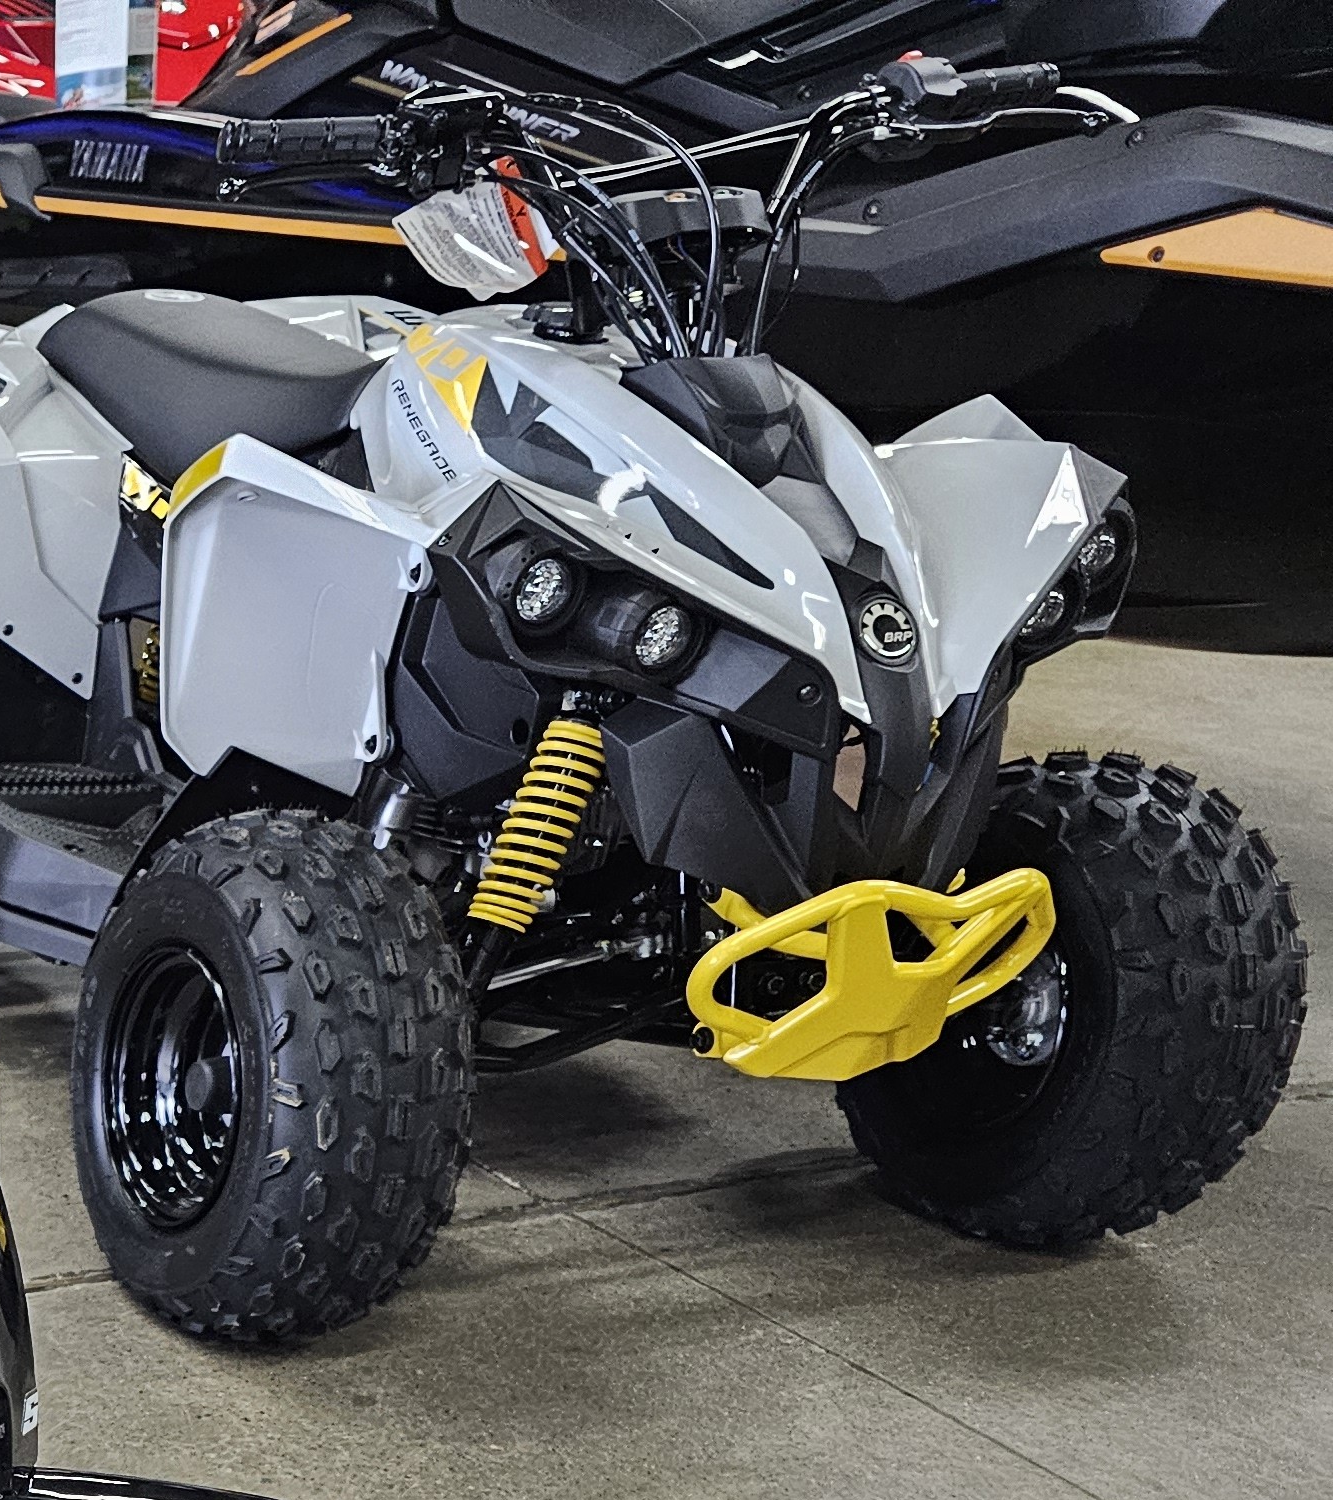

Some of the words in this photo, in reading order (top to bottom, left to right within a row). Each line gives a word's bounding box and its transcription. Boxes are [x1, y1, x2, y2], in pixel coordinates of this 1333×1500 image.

[69, 139, 150, 183] YAMAHA
[391, 377, 458, 483] RENEGADE
[884, 631, 913, 643] BRP
